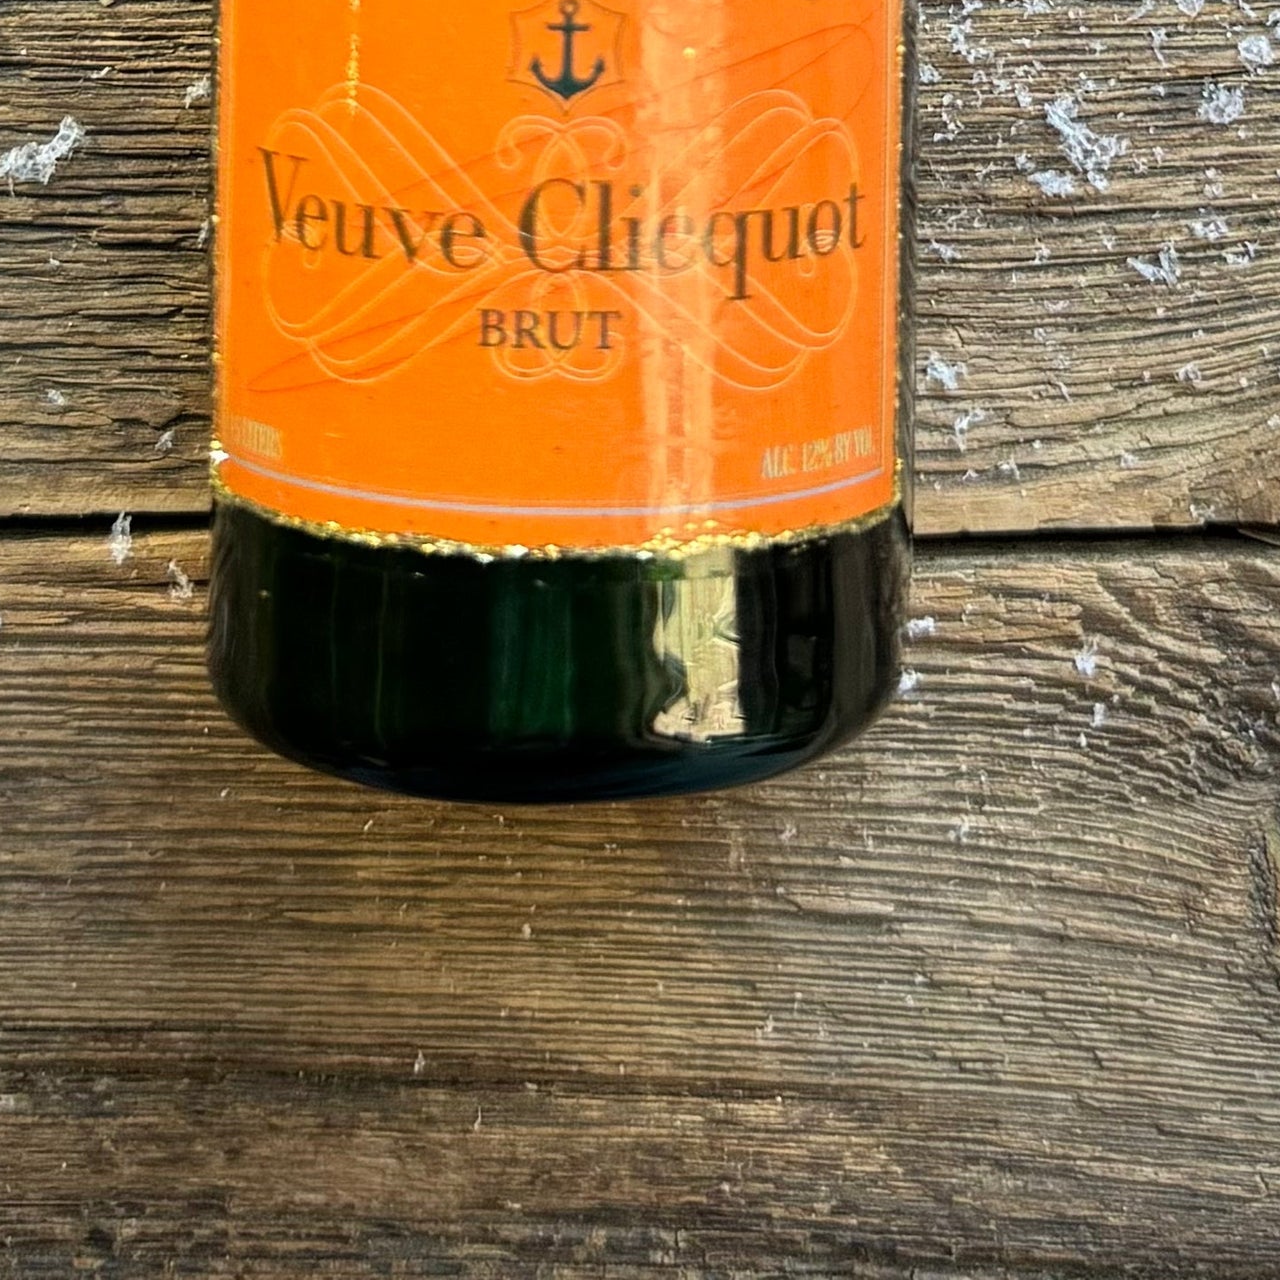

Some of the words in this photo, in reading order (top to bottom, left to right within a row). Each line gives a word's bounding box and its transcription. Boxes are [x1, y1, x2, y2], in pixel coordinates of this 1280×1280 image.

[255, 145, 490, 269] Veuve
[518, 177, 867, 301] Clicquot
[475, 307, 622, 351] BRUT
[835, 430, 852, 465] BY
